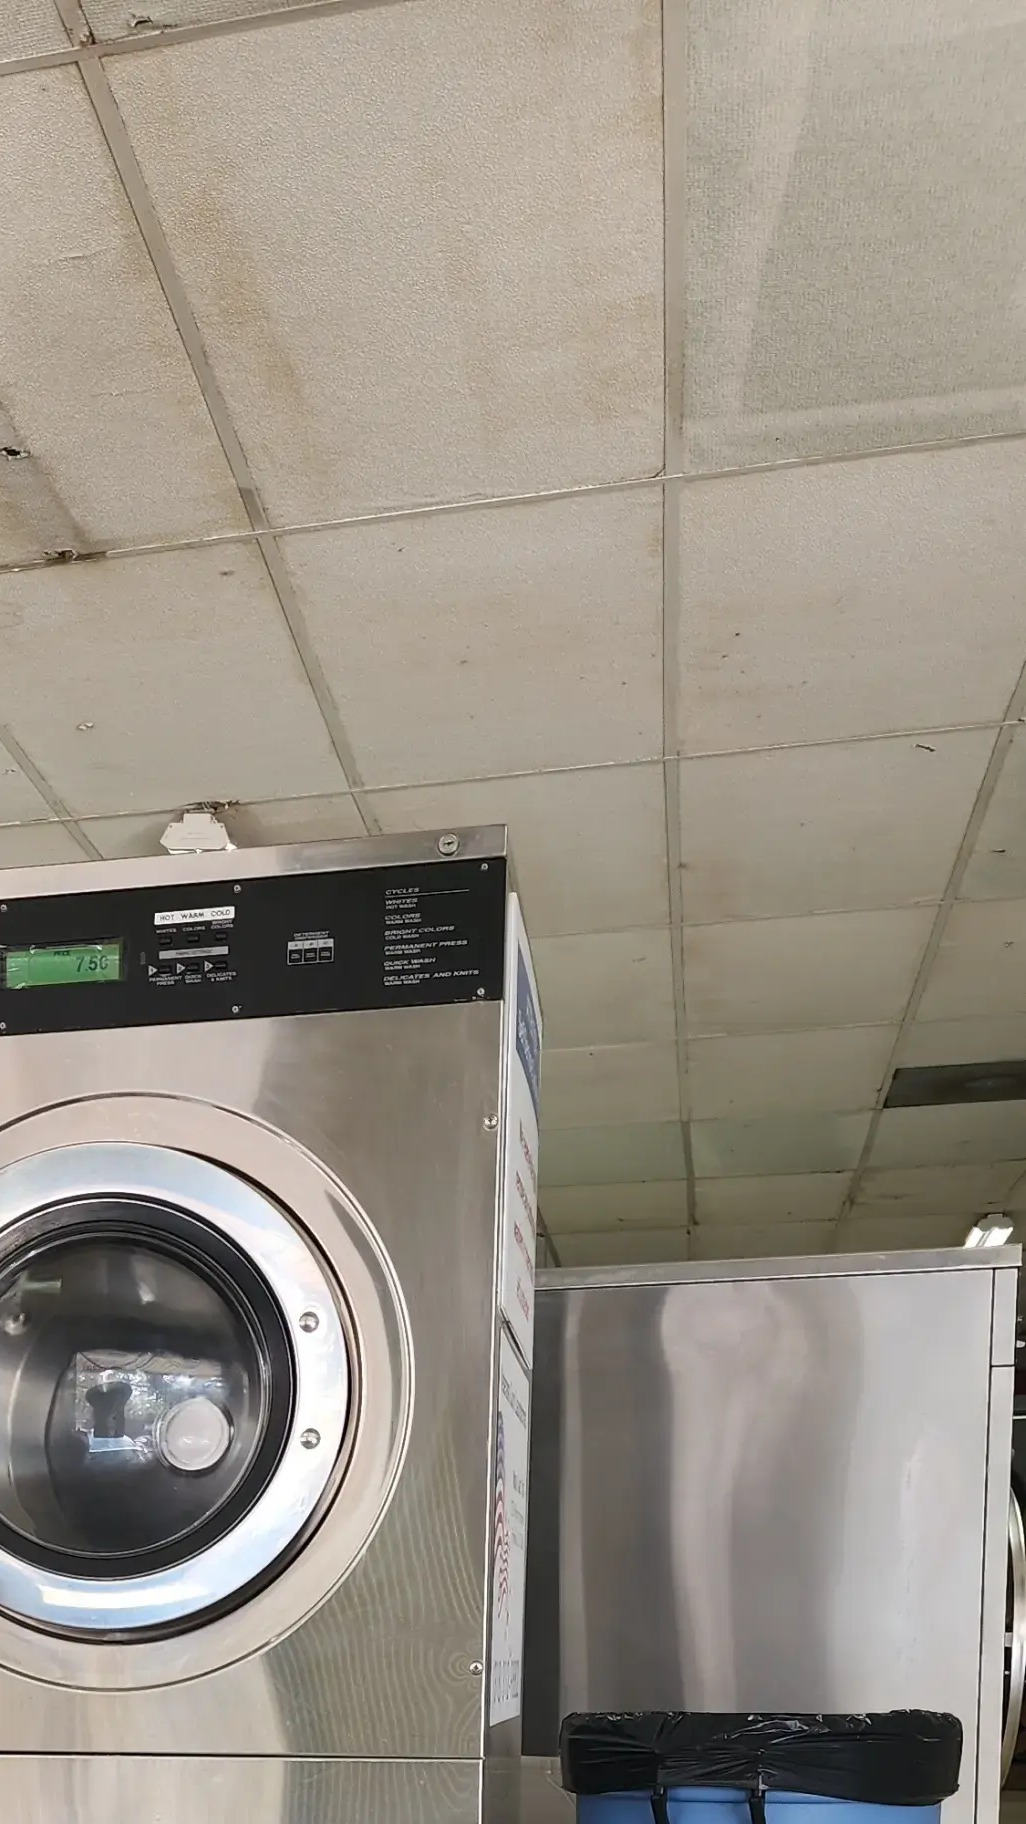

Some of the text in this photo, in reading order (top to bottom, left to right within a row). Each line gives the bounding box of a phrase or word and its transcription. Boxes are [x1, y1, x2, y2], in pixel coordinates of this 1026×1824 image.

[385, 887, 420, 895] CYCLES
[384, 912, 421, 920] COLORS
[384, 925, 455, 936] BRIGHT COLORS
[384, 942, 438, 950] PERMANENT
[384, 973, 430, 982] DELICATES
